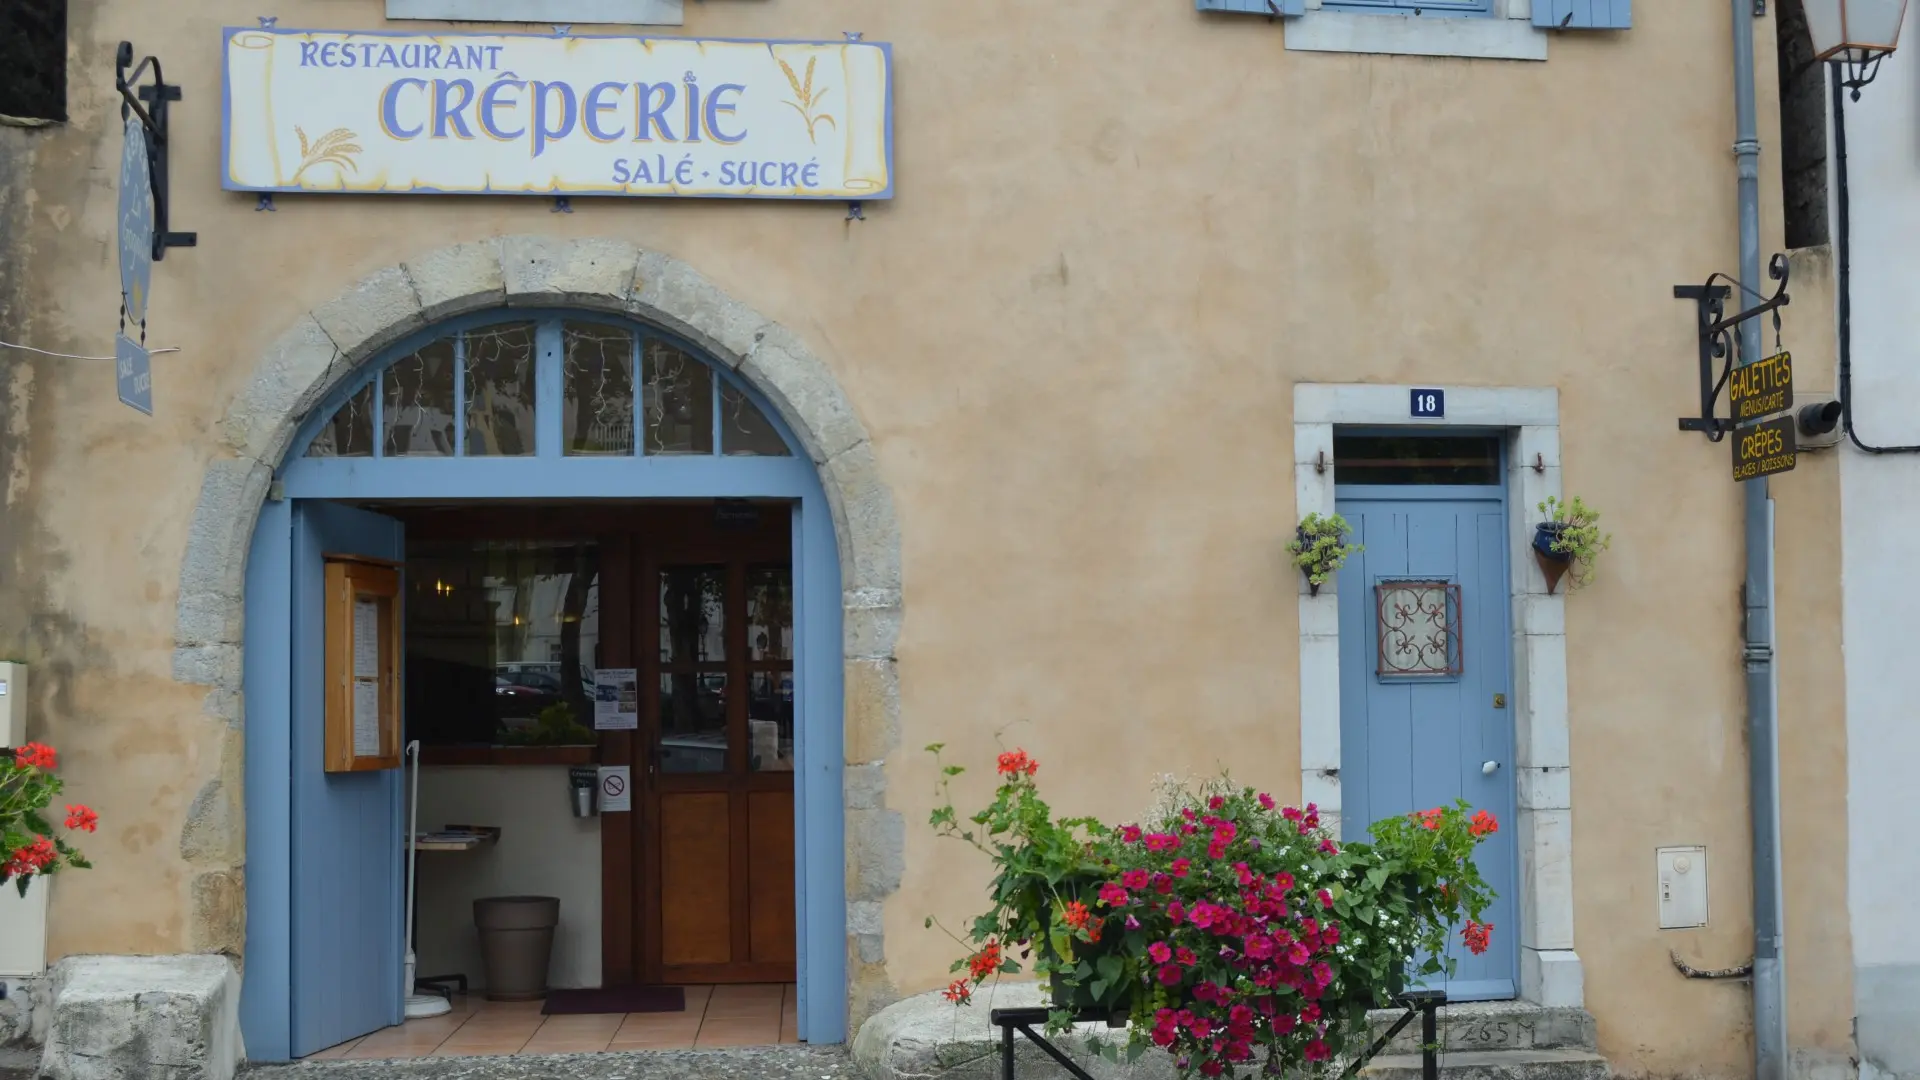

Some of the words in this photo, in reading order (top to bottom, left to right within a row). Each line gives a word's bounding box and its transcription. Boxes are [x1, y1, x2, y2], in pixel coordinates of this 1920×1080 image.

[300, 41, 504, 71] RESTAURANT
[378, 71, 748, 158] CRÊPERIE
[611, 153, 694, 185] SALÉ
[718, 157, 820, 188] SUCRÉ
[1730, 354, 1791, 401] GALETTES
[1417, 394, 1436, 412] 18
[1739, 391, 1784, 418] MENUS/CARTE
[1741, 424, 1782, 460] CRÊPES
[1733, 463, 1756, 480] GLACES
[1761, 453, 1794, 473] BOISSONS
